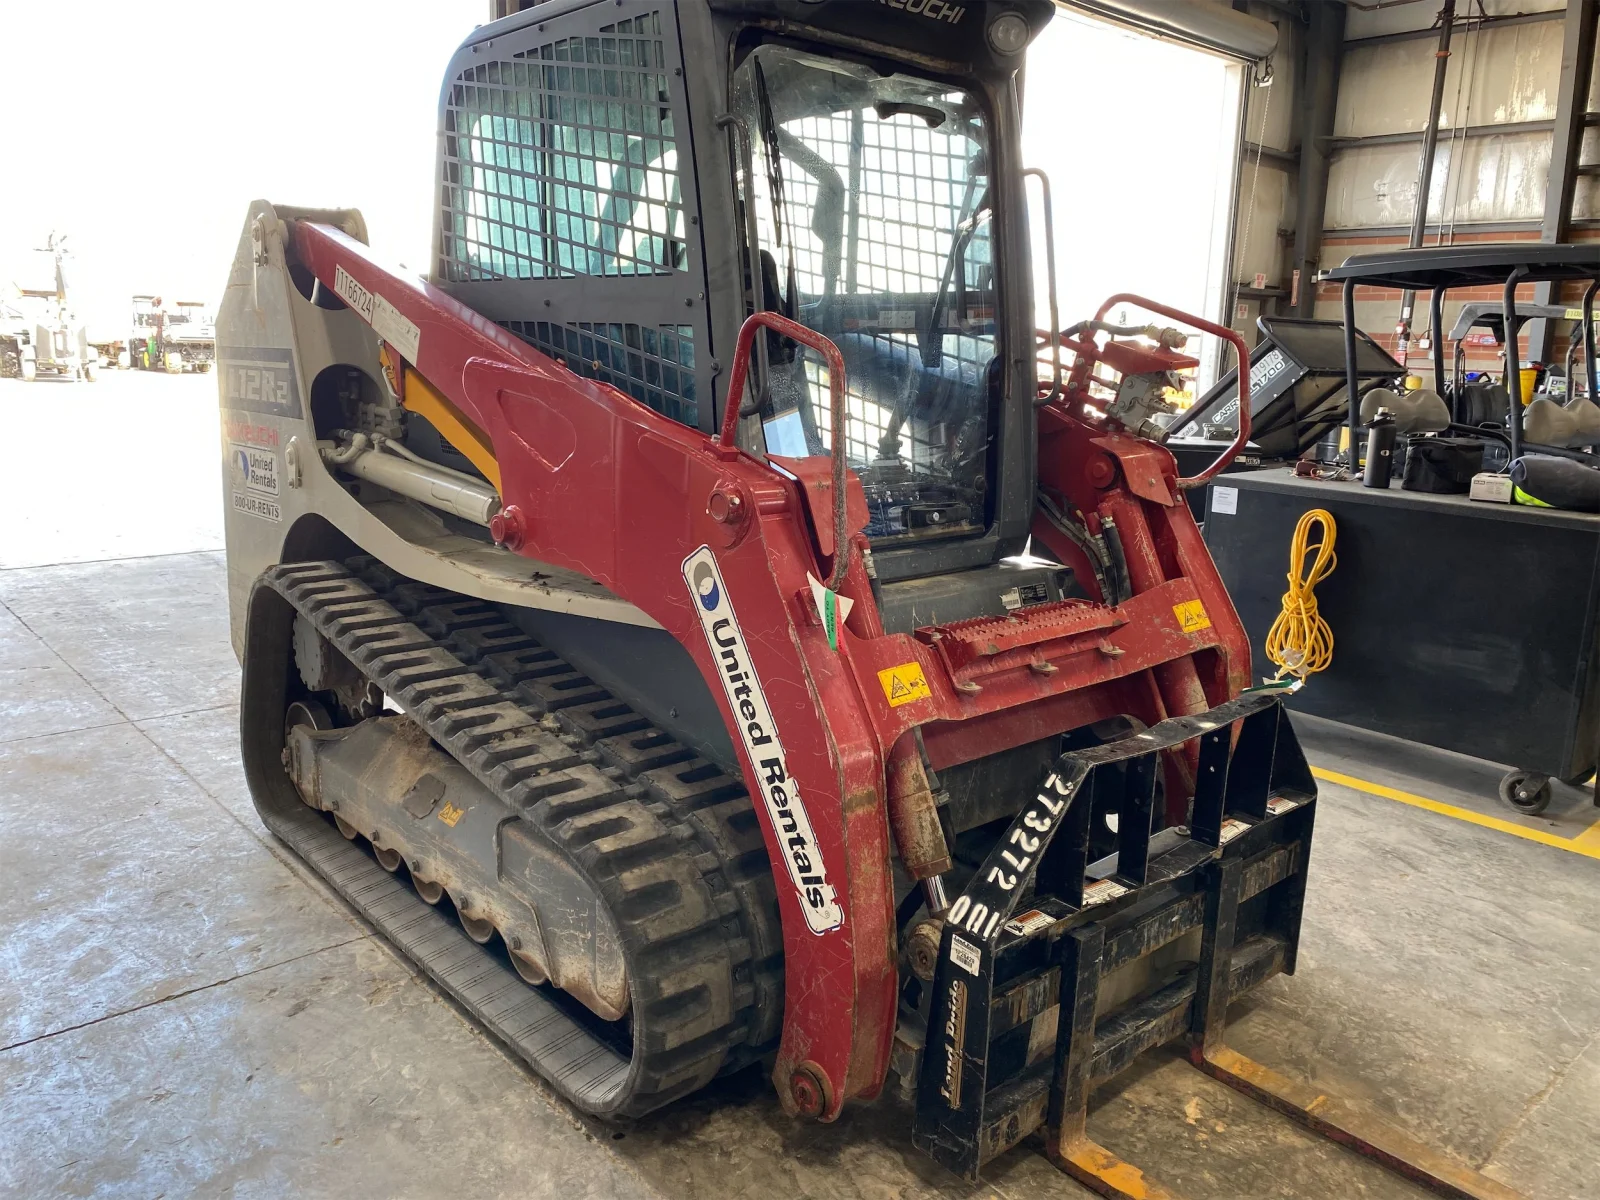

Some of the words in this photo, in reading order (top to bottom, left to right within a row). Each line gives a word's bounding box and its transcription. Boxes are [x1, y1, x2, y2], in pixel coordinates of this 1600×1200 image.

[872, 0, 966, 24] EUCHI
[335, 267, 372, 316] 11166724
[250, 453, 273, 472] United
[250, 472, 277, 490] Rentals
[234, 495, 280, 519] 800-UR-RENTS
[712, 617, 772, 748] United
[759, 757, 824, 910] Rentals
[987, 773, 1074, 890] 273272
[945, 979, 964, 1038] Pride
[941, 1042, 957, 1104] Land
